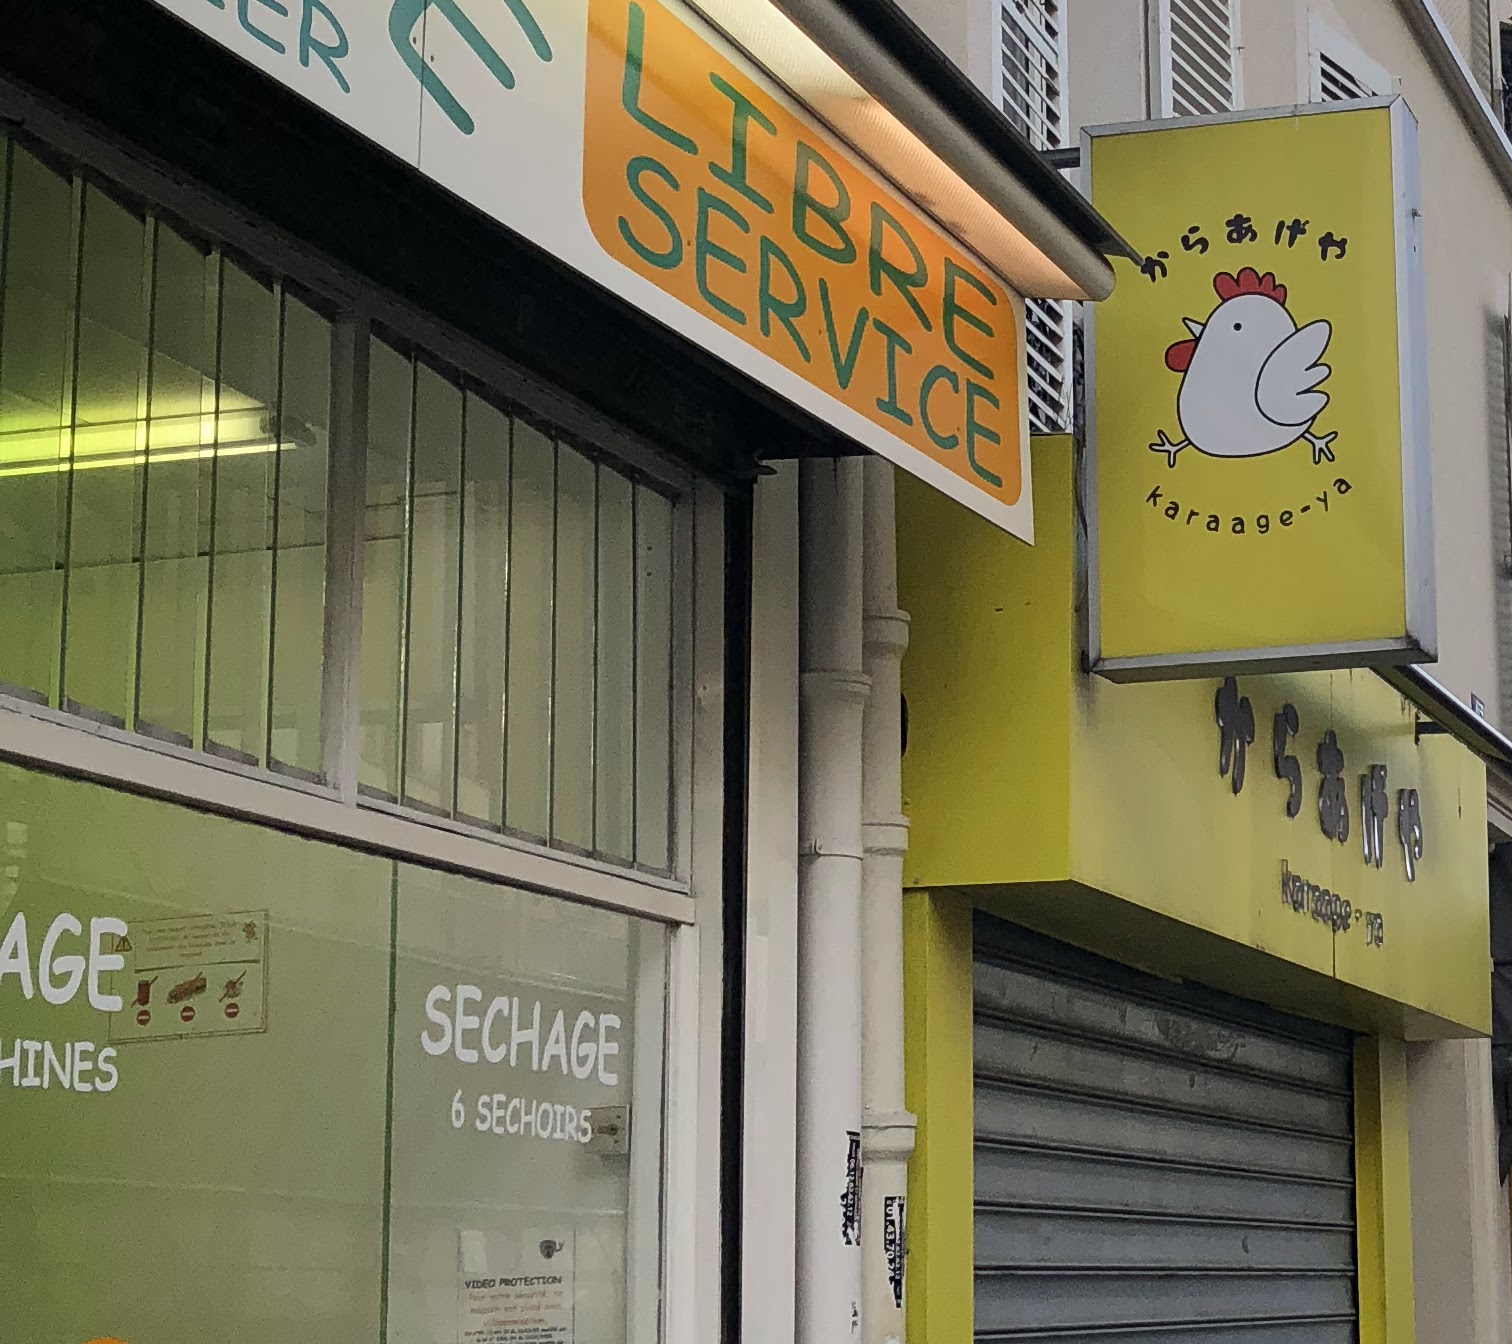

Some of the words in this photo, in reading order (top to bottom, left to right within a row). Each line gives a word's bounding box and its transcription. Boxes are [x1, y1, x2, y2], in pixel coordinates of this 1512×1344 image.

[621, 1, 998, 380] LIBRE
[1140, 213, 1348, 283] からあげや
[617, 155, 1003, 489] SERVICE
[1145, 476, 1353, 535] karaage-ya
[0, 911, 128, 1012] AGE
[420, 984, 621, 1086] SECHAGE
[451, 1088, 465, 1129] 6
[475, 1093, 593, 1144] SECHOIRS
[464, 1278, 496, 1289] VIDEO
[499, 1275, 562, 1287] PROTECTION
